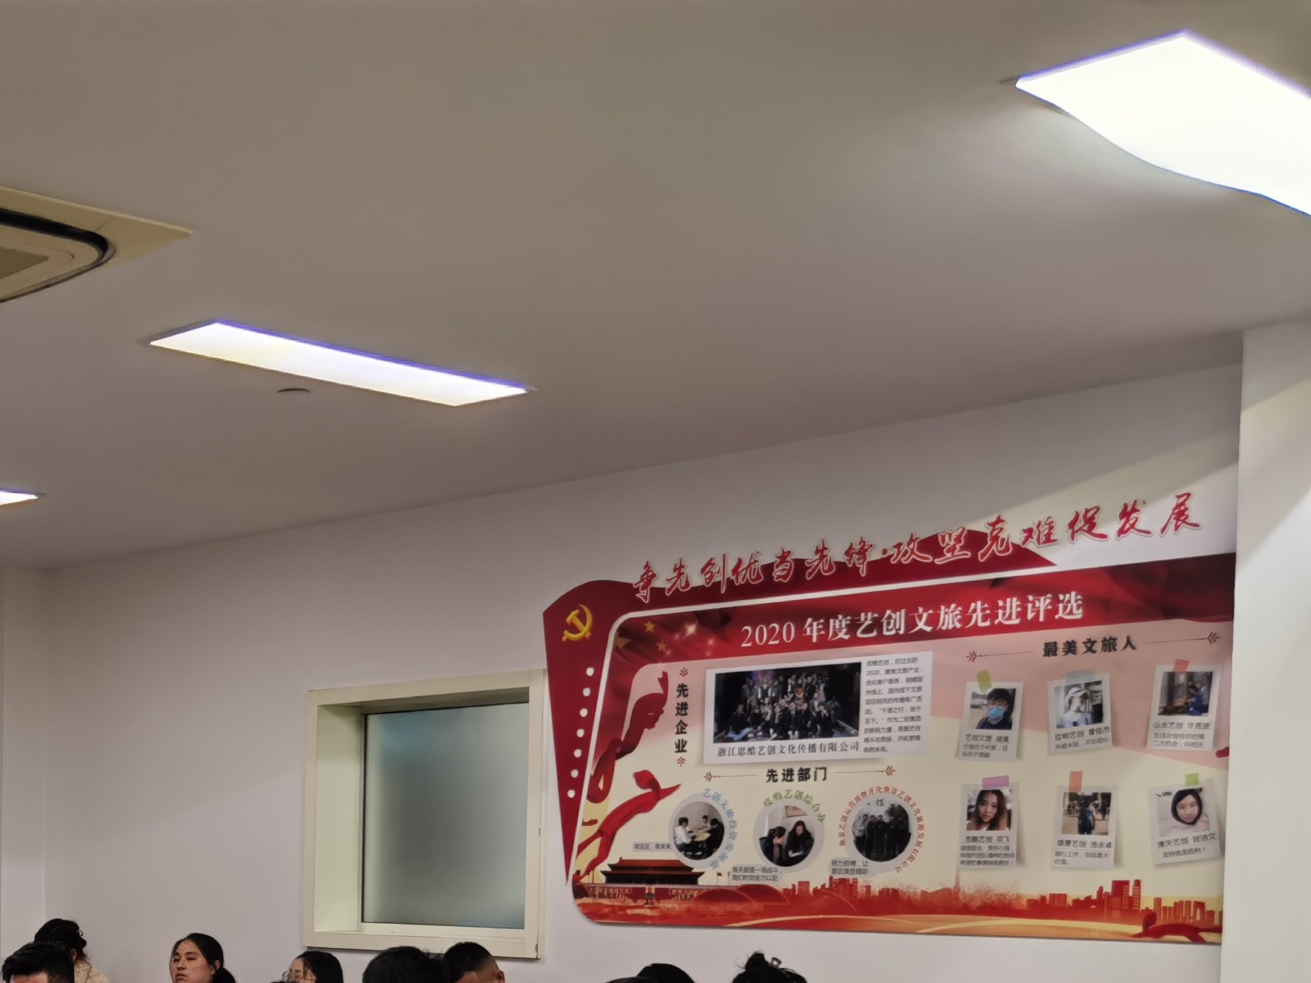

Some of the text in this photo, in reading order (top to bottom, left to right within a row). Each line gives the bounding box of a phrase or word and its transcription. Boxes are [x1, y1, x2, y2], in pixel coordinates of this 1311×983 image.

[1042, 635, 1137, 658] 最美文旅人
[674, 683, 689, 753] 先进企业
[717, 741, 860, 757] 浙江思酷艺创文化传播有限公司
[765, 766, 827, 783] 先进部门
